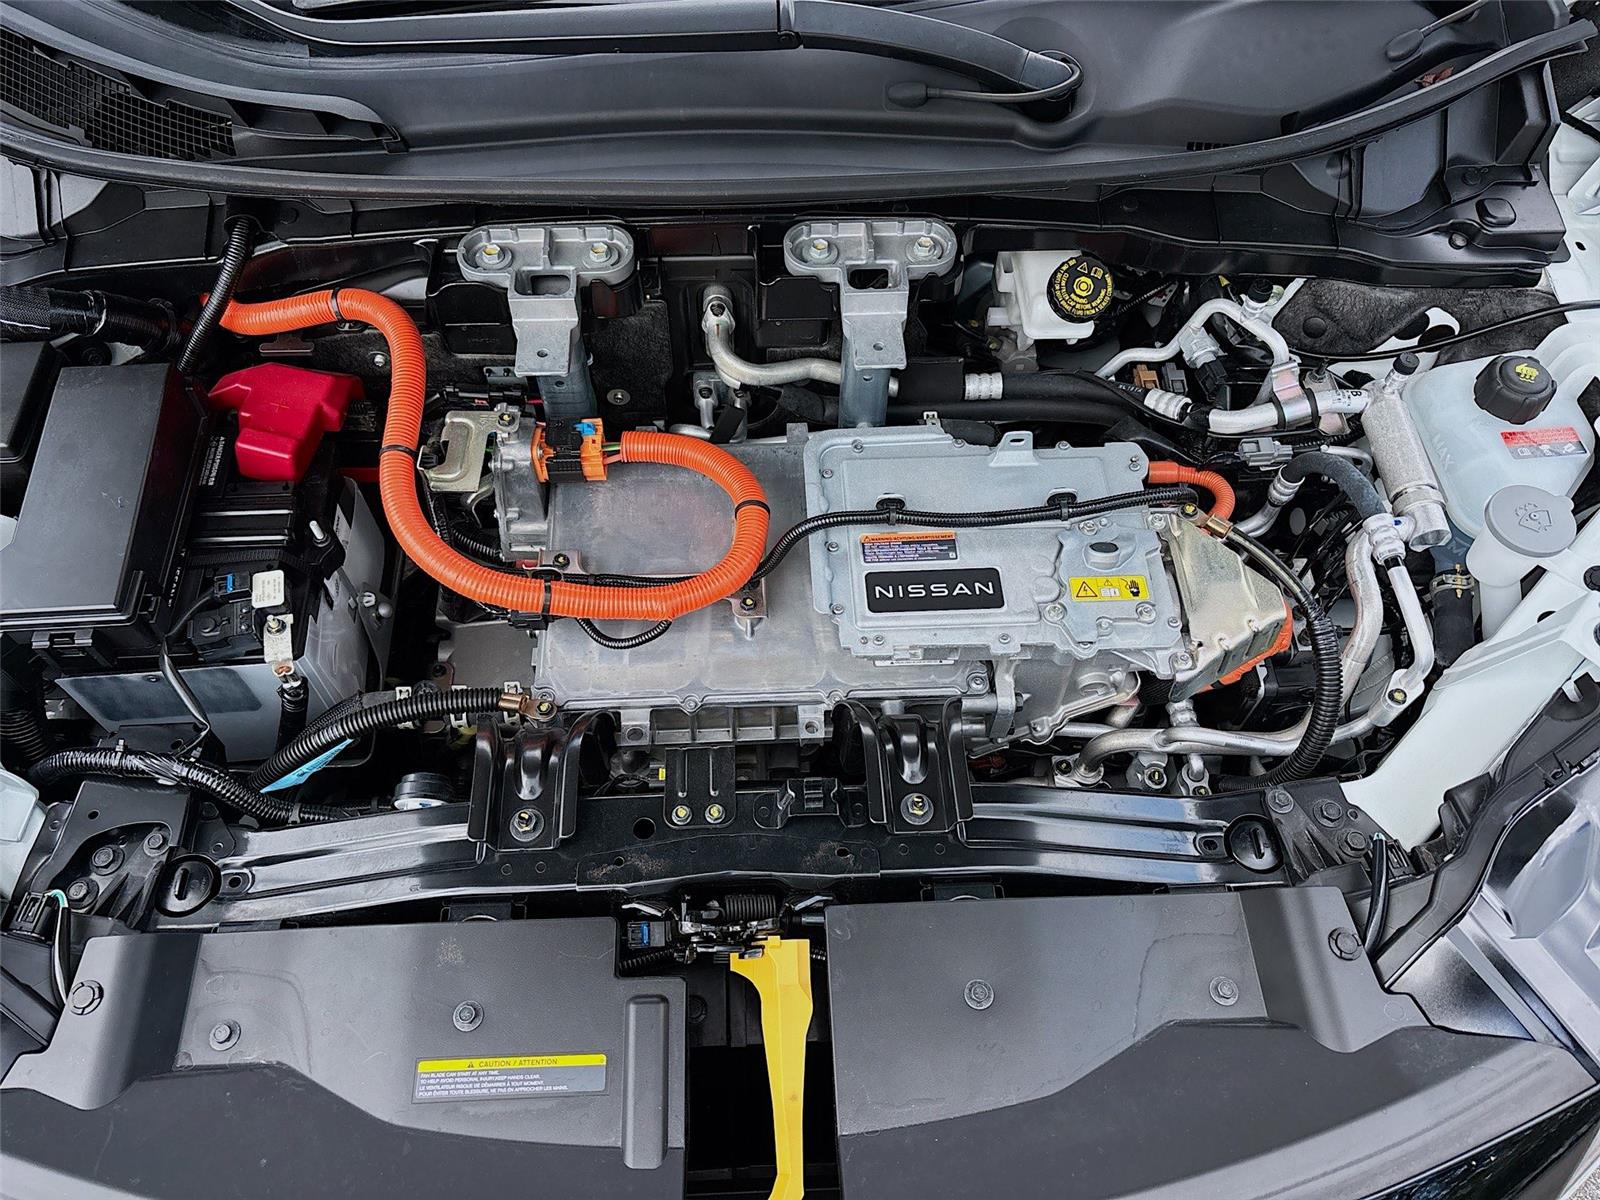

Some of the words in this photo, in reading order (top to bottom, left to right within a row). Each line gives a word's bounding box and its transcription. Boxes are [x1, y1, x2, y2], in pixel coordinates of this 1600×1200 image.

[1061, 273, 1069, 286] CLEAN
[1061, 287, 1069, 300] FILLER
[875, 582, 994, 598] NISSAN
